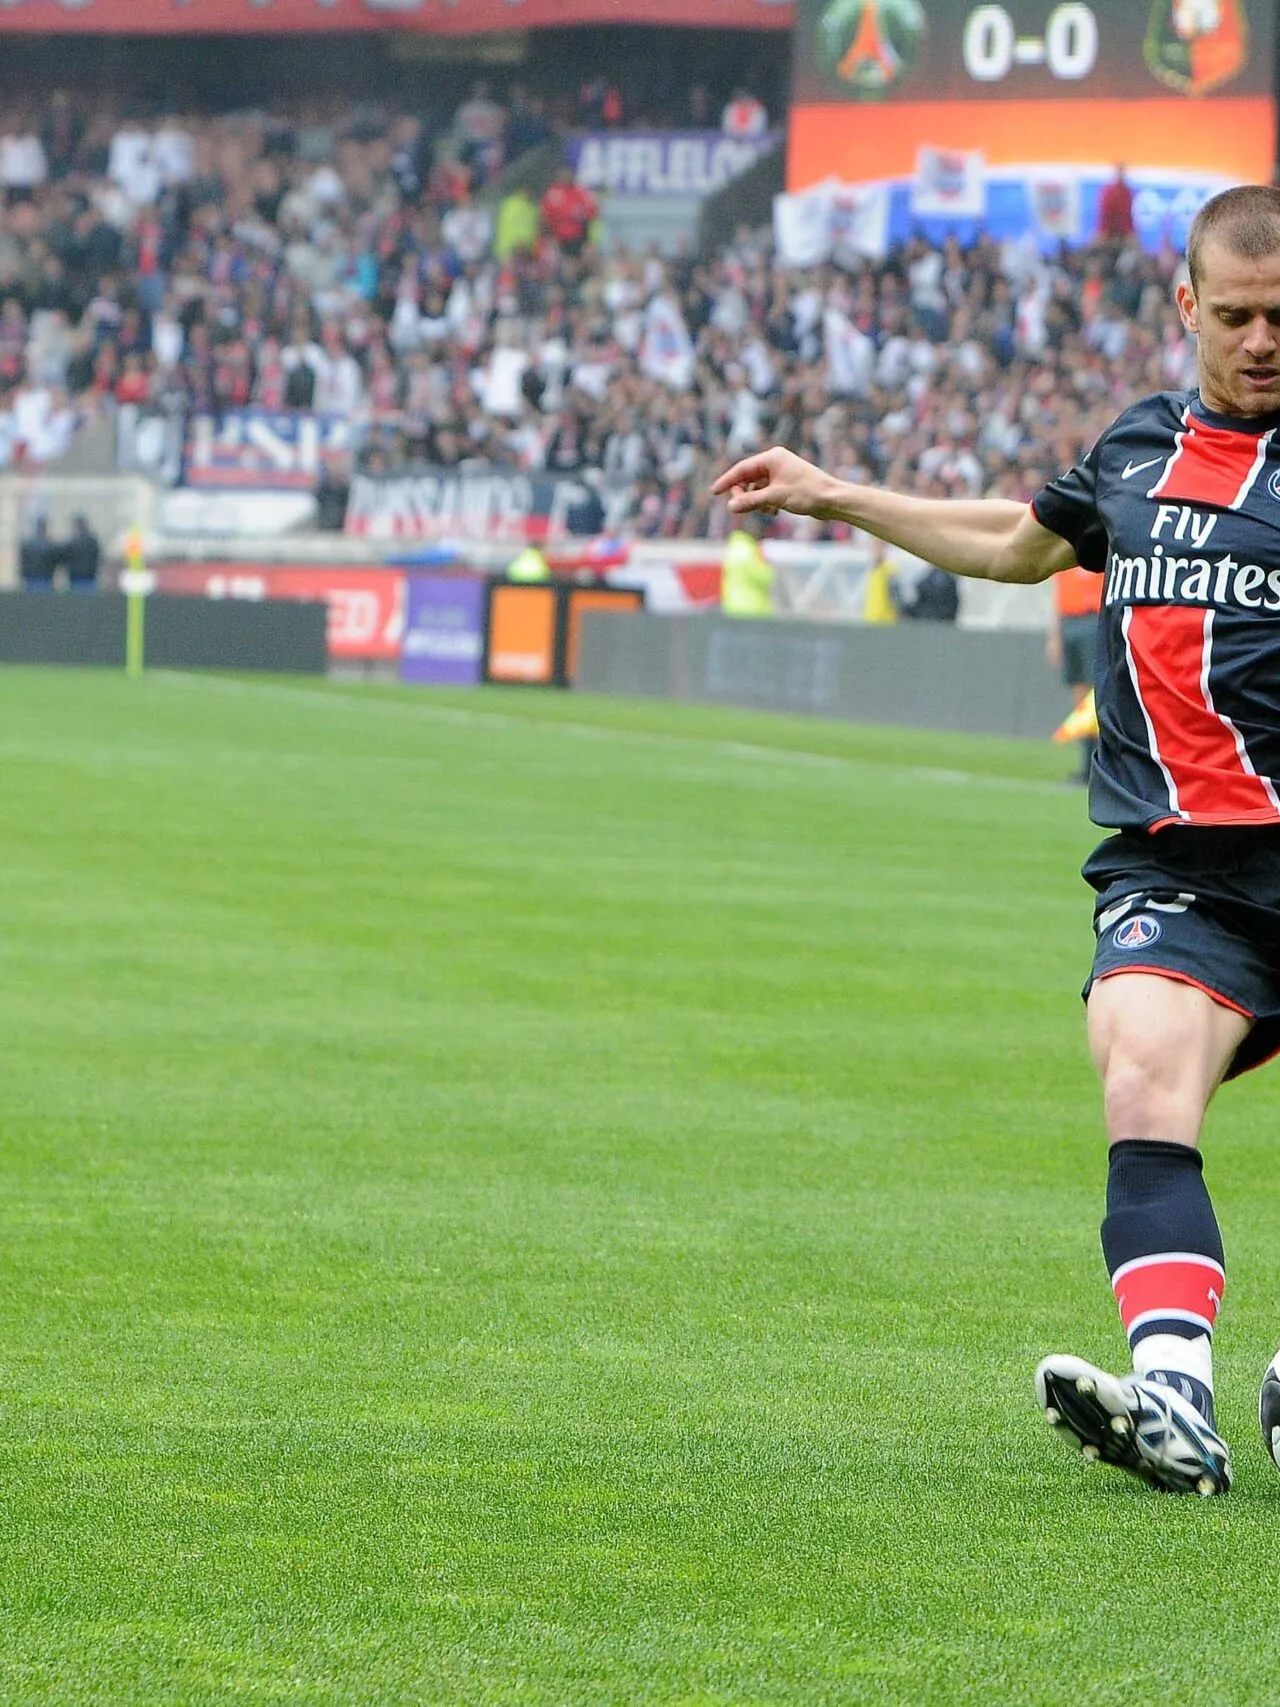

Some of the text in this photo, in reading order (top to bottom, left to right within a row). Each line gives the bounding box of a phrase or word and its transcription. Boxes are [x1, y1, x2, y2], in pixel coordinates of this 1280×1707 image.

[963, 2, 1098, 82] 0-0
[575, 138, 757, 194] AFFLELO
[1150, 504, 1218, 549] Fly
